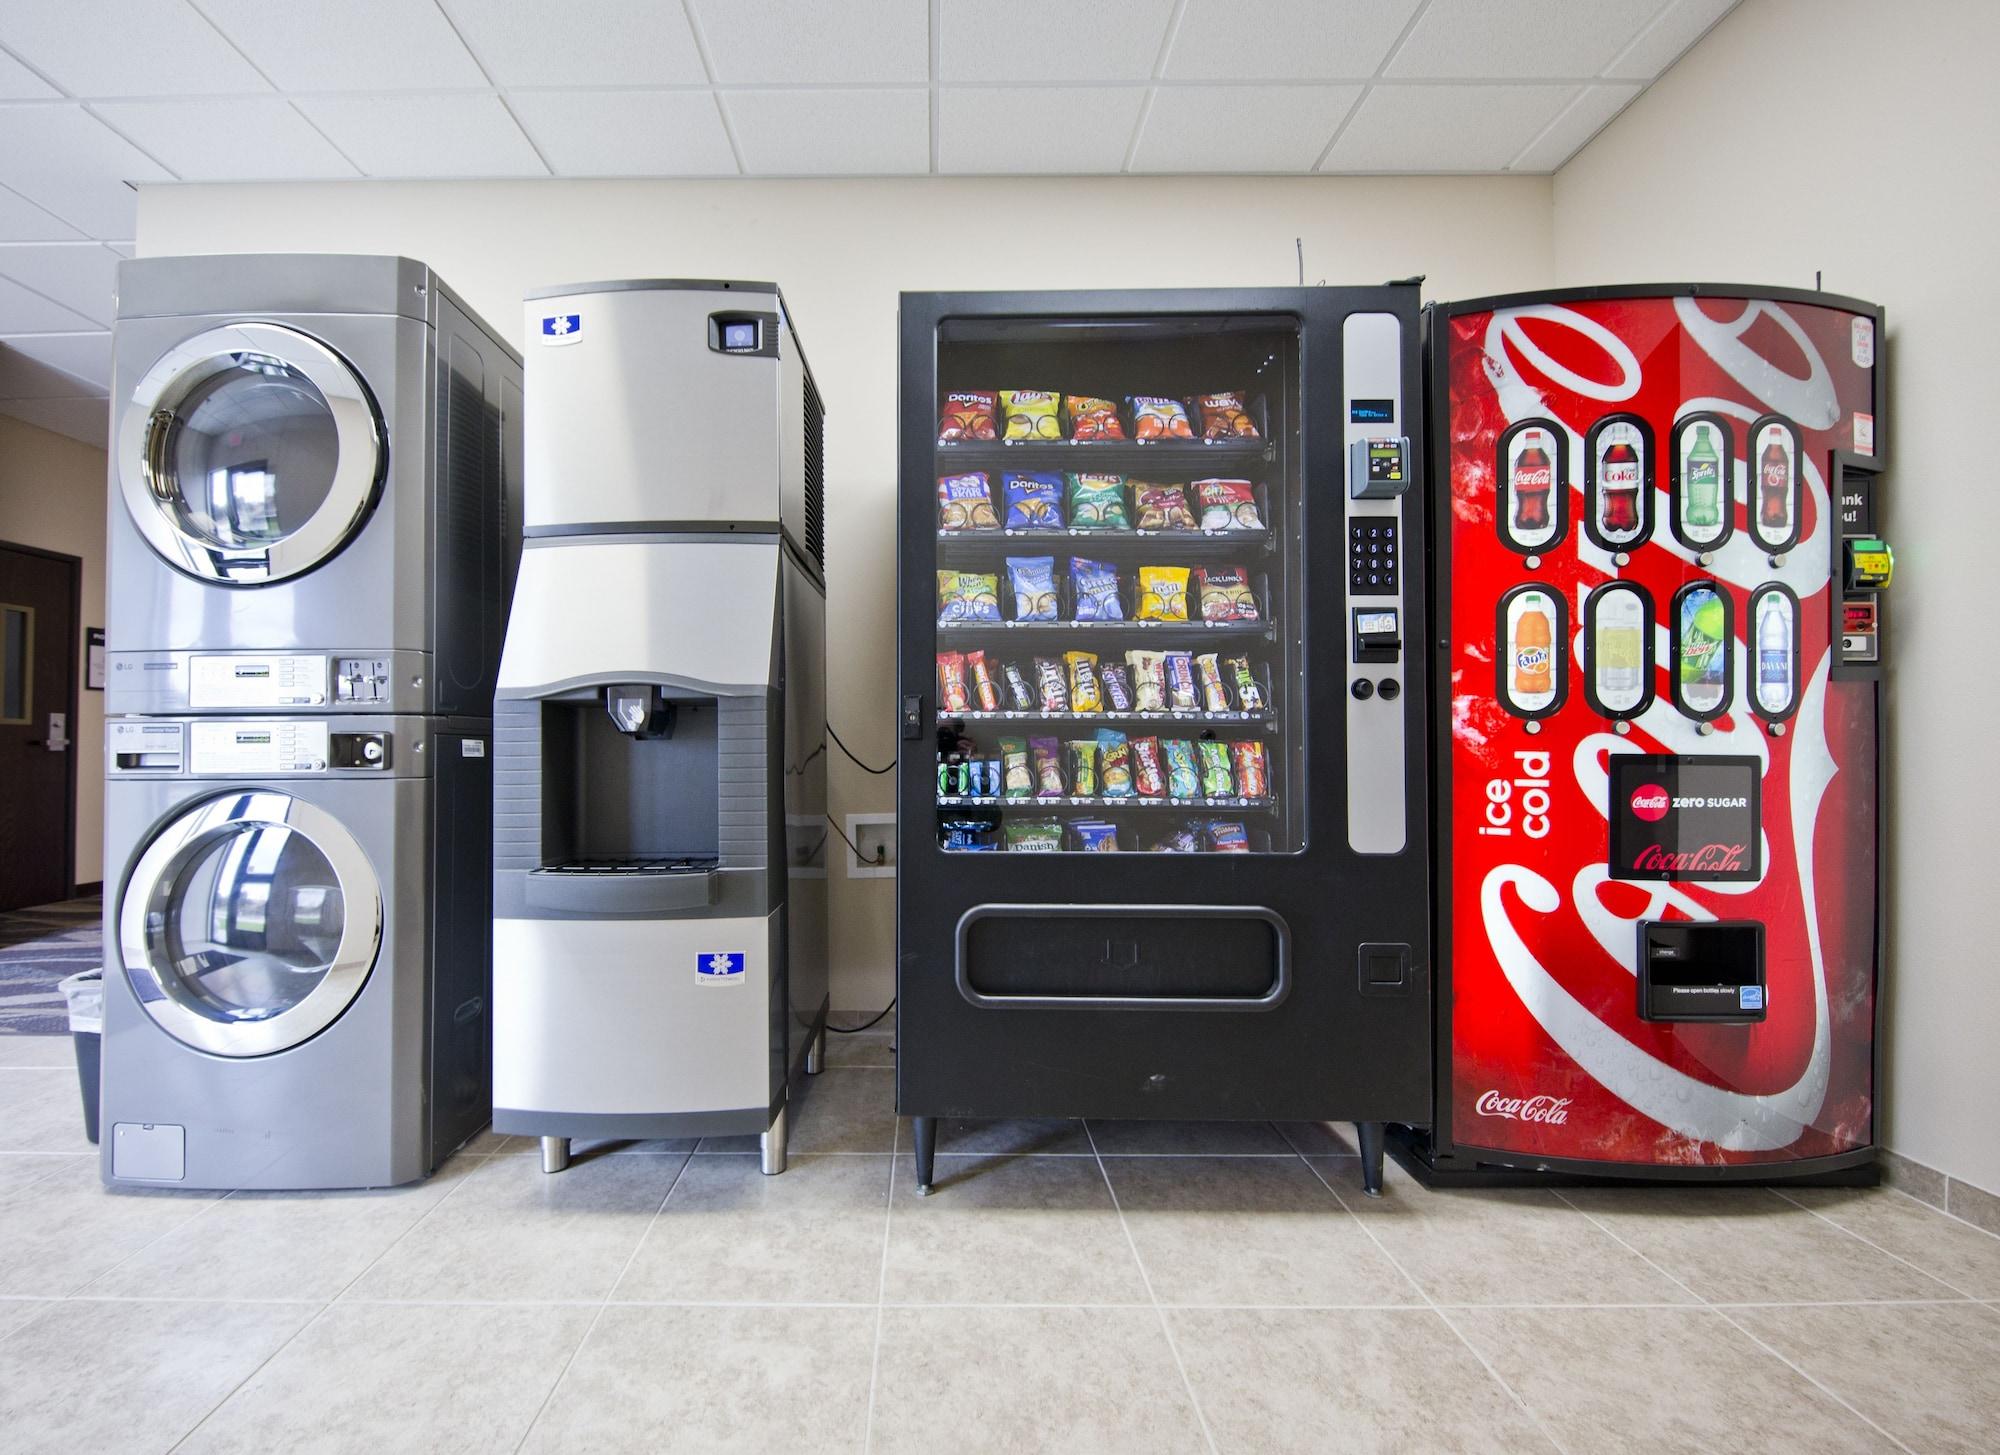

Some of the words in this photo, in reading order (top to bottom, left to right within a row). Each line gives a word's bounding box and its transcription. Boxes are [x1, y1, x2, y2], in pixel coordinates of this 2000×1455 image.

[948, 393, 992, 405] Doritos
[1514, 469, 1550, 486] Coca-Cola
[1604, 470, 1635, 481] Coke
[1692, 468, 1715, 481] Sprite
[1010, 479, 1054, 490] Doritos
[1841, 510, 1857, 522] u!
[1517, 650, 1547, 667] Fanta
[1514, 751, 1550, 839] cold
[1478, 778, 1512, 836] ice
[1631, 796, 1668, 809] Coca-Cola
[1672, 797, 1705, 808] zero
[1707, 797, 1747, 808] SUGAR
[1014, 842, 1054, 851] Danish
[1633, 842, 1748, 871] Coca-Cola
[1720, 987, 1736, 995] slowly
[1476, 1089, 1573, 1125] Coca-Cola
